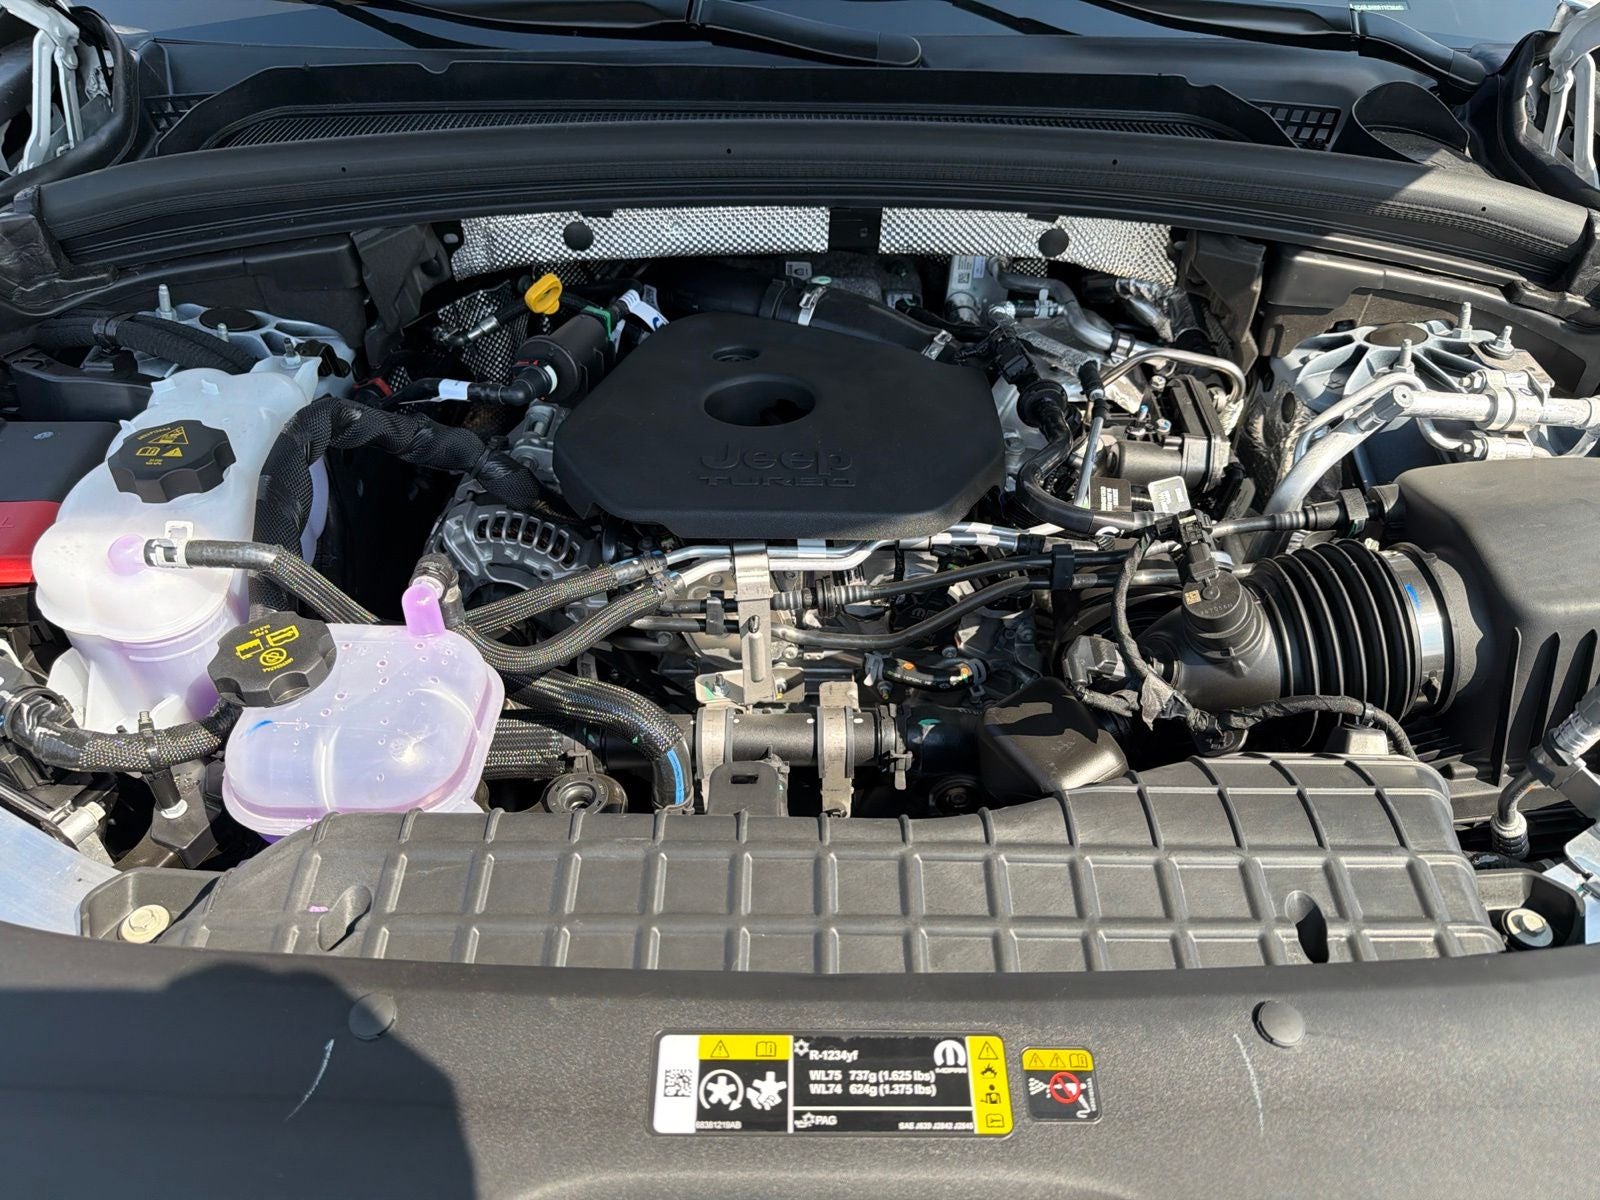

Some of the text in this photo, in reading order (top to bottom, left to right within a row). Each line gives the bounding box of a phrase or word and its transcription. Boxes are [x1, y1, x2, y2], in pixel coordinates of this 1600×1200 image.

[699, 440, 854, 476] Jeep
[809, 1049, 859, 1063] R-1234yf
[808, 1070, 936, 1083] WL75 737g (1.625 lbs)
[808, 1084, 937, 1097] WL74 624g (1.375 lbs)
[815, 1115, 838, 1126] PAG
